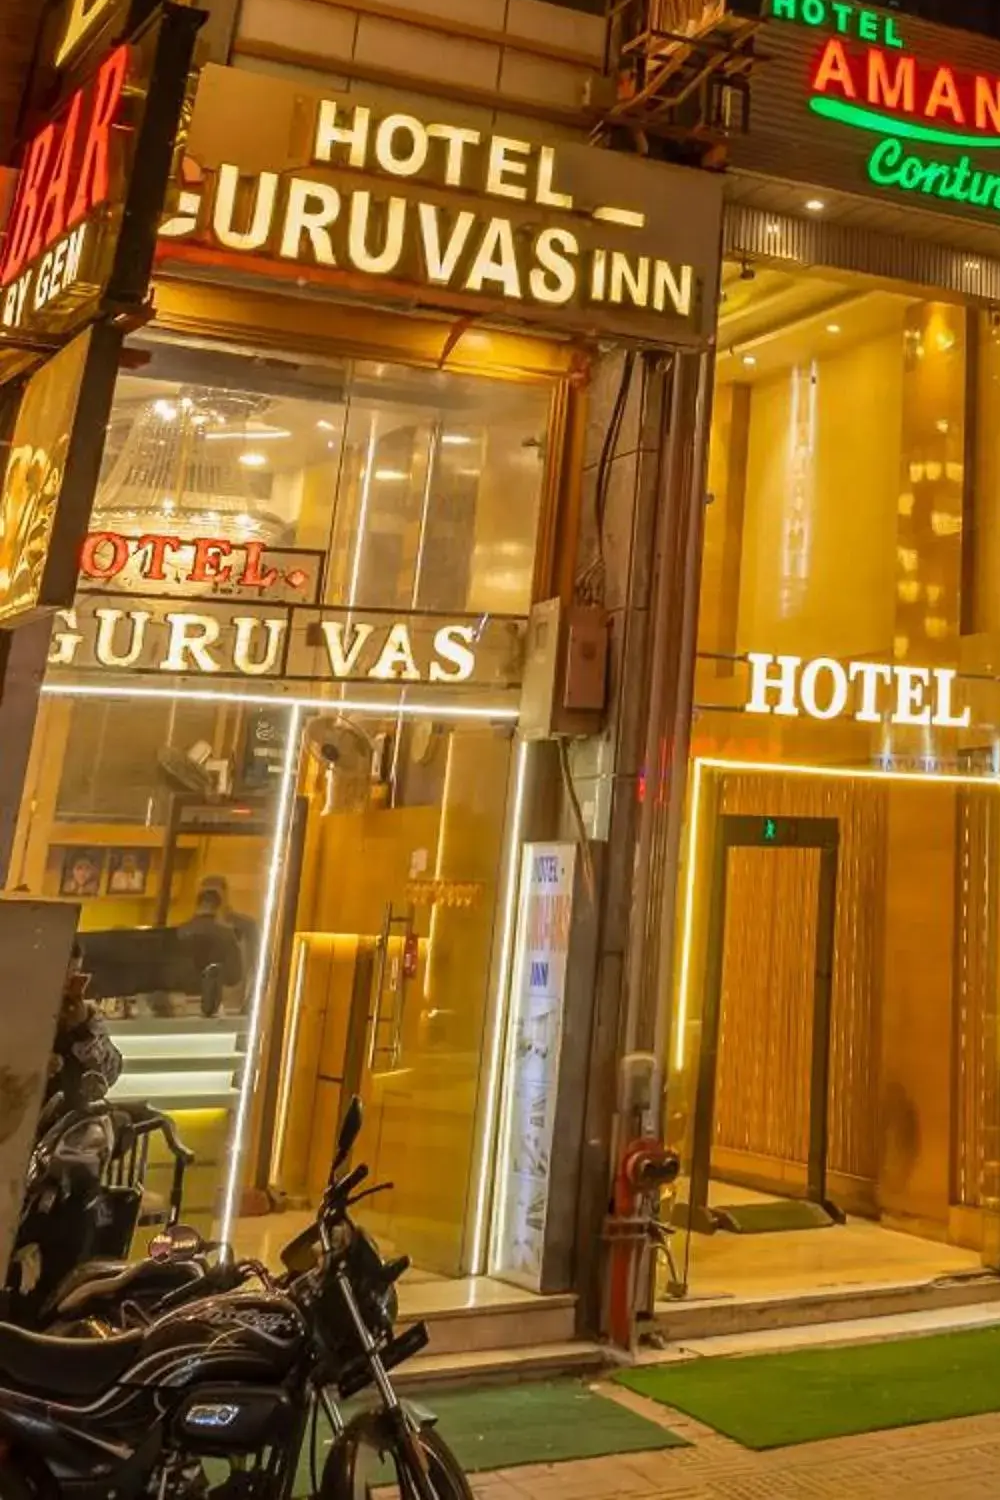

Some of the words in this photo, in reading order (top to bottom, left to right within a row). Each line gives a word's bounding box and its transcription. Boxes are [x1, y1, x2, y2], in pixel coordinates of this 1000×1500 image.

[314, 99, 573, 209] HOTEL
[33, 222, 87, 310] GEM
[157, 162, 577, 303] URUVAS
[591, 249, 693, 318] INN
[80, 531, 278, 588] OTEL
[320, 620, 479, 683] VAS
[747, 651, 970, 728] HOTEL
